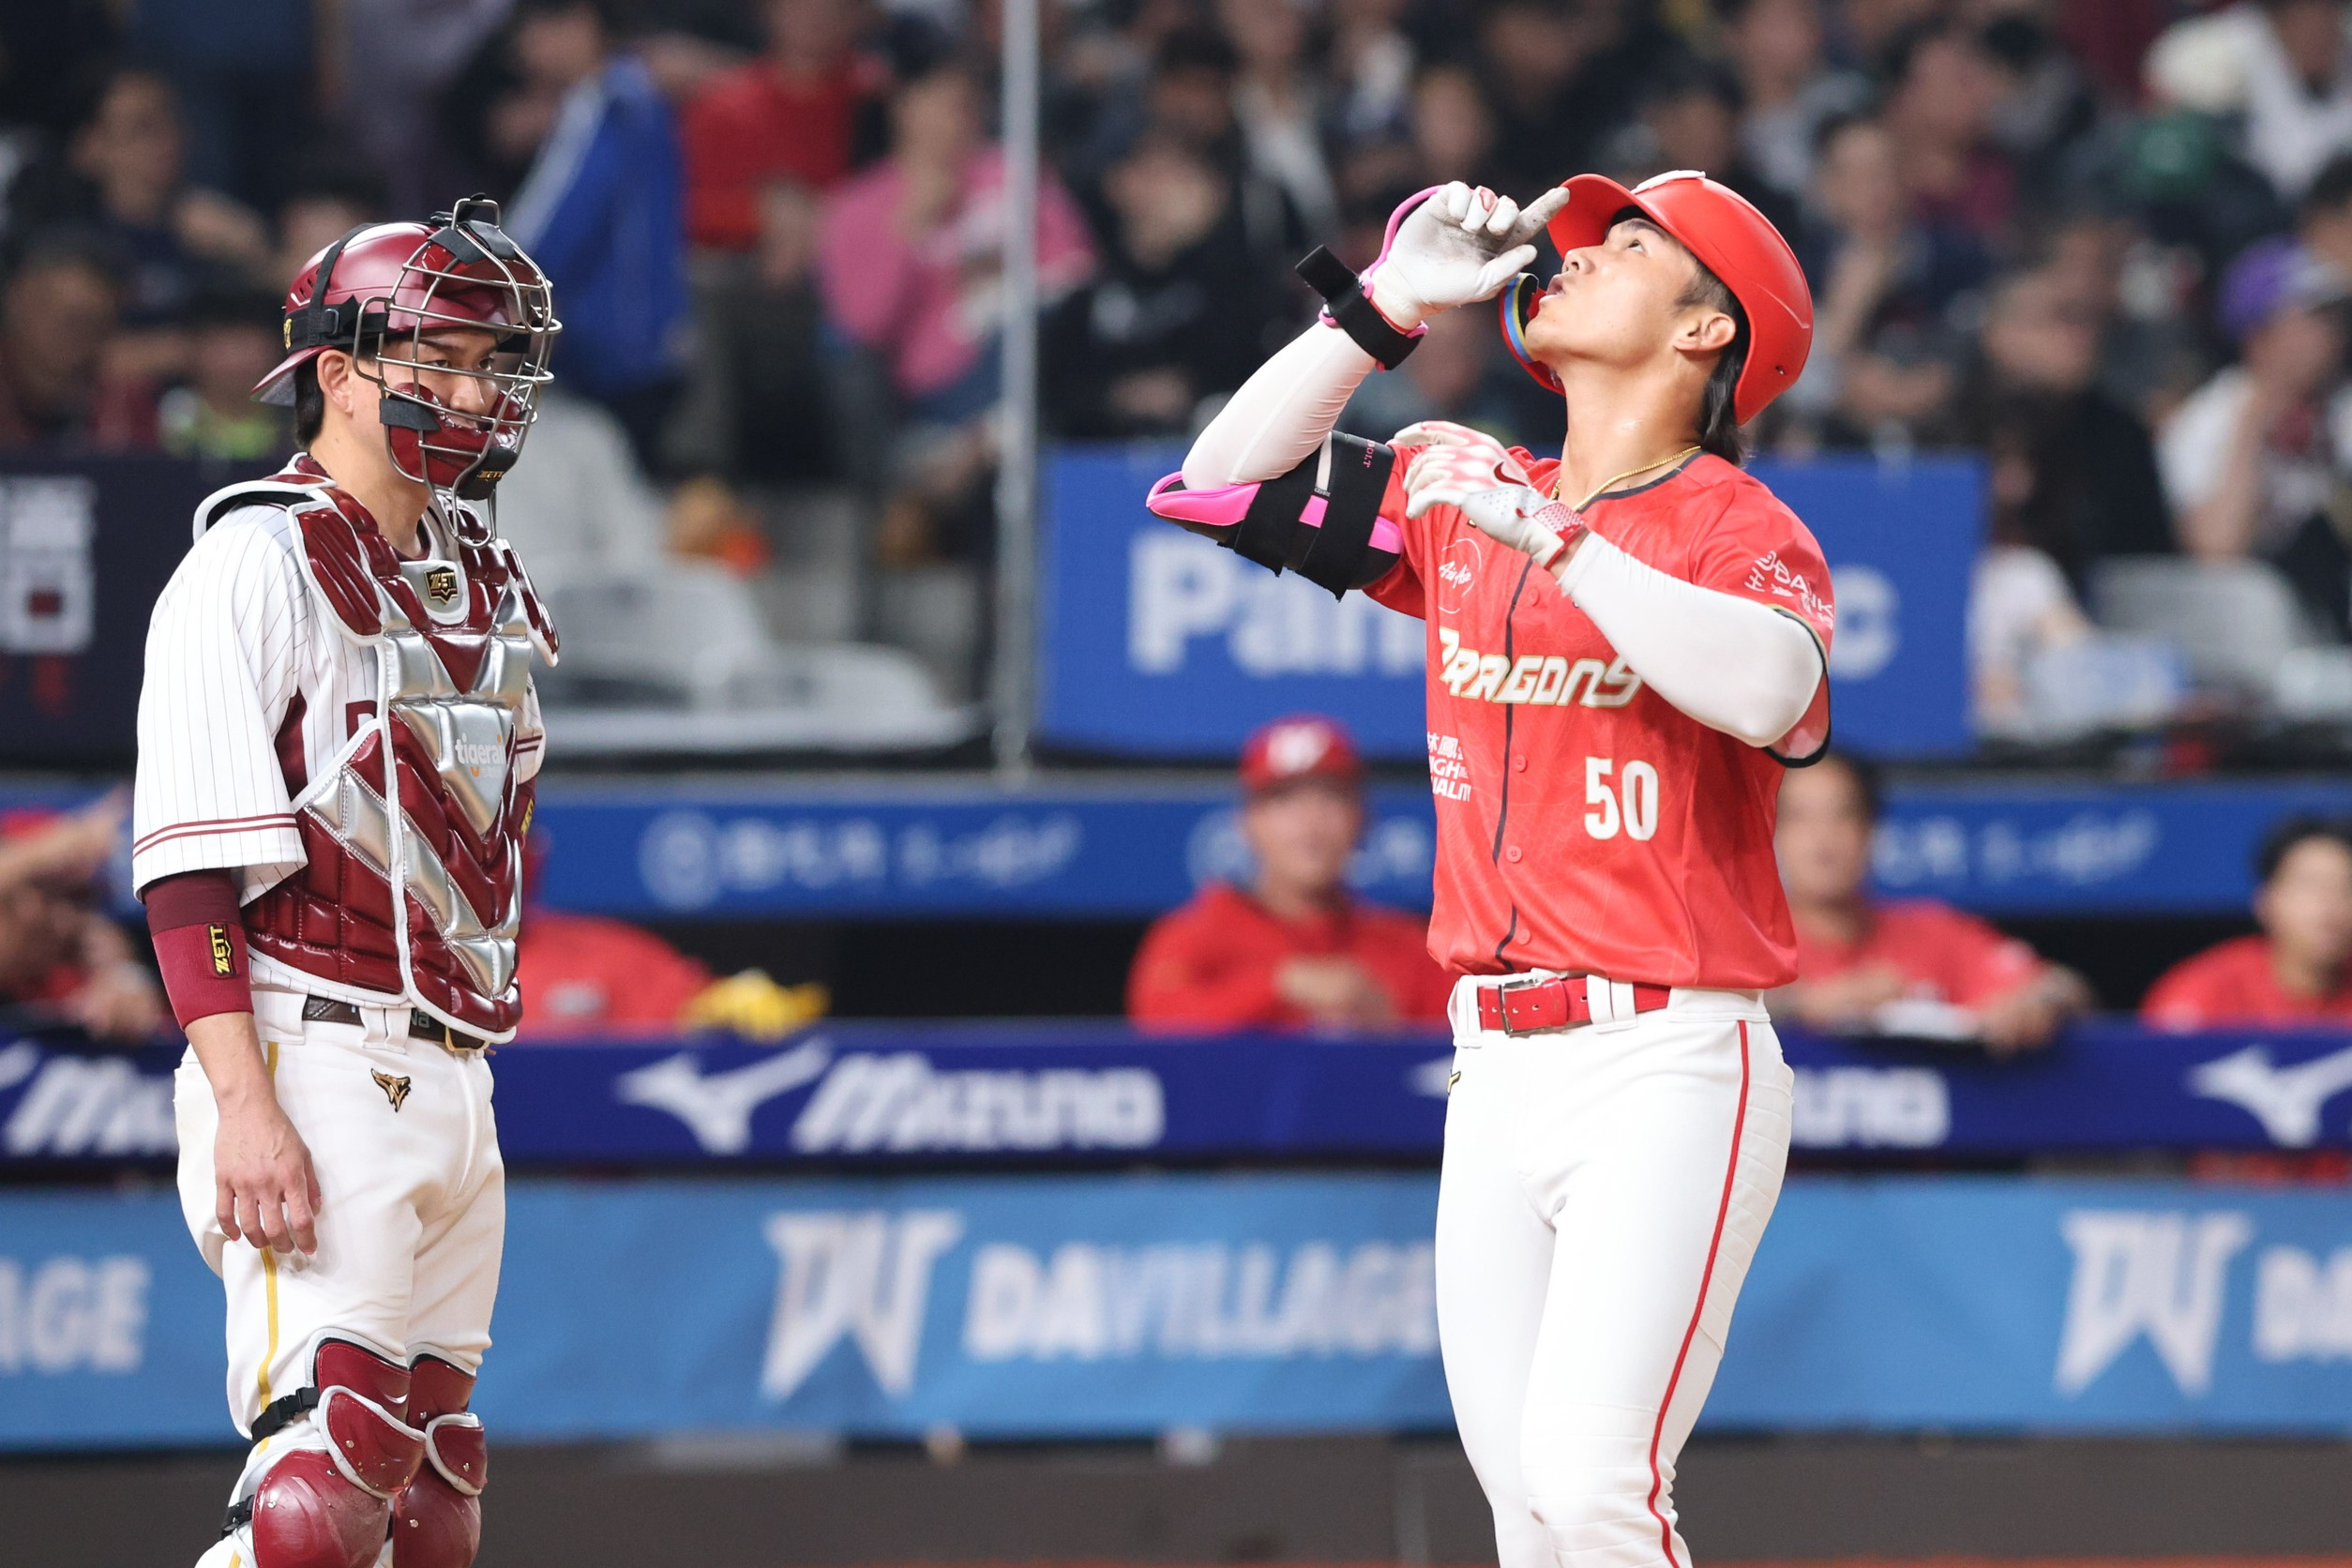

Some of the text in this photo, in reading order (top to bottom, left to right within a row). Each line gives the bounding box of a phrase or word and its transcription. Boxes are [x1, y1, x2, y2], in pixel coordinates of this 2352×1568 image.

[1439, 626, 1642, 709] DRAGONS
[1584, 755, 1659, 841] 50
[209, 926, 231, 973] ZETT
